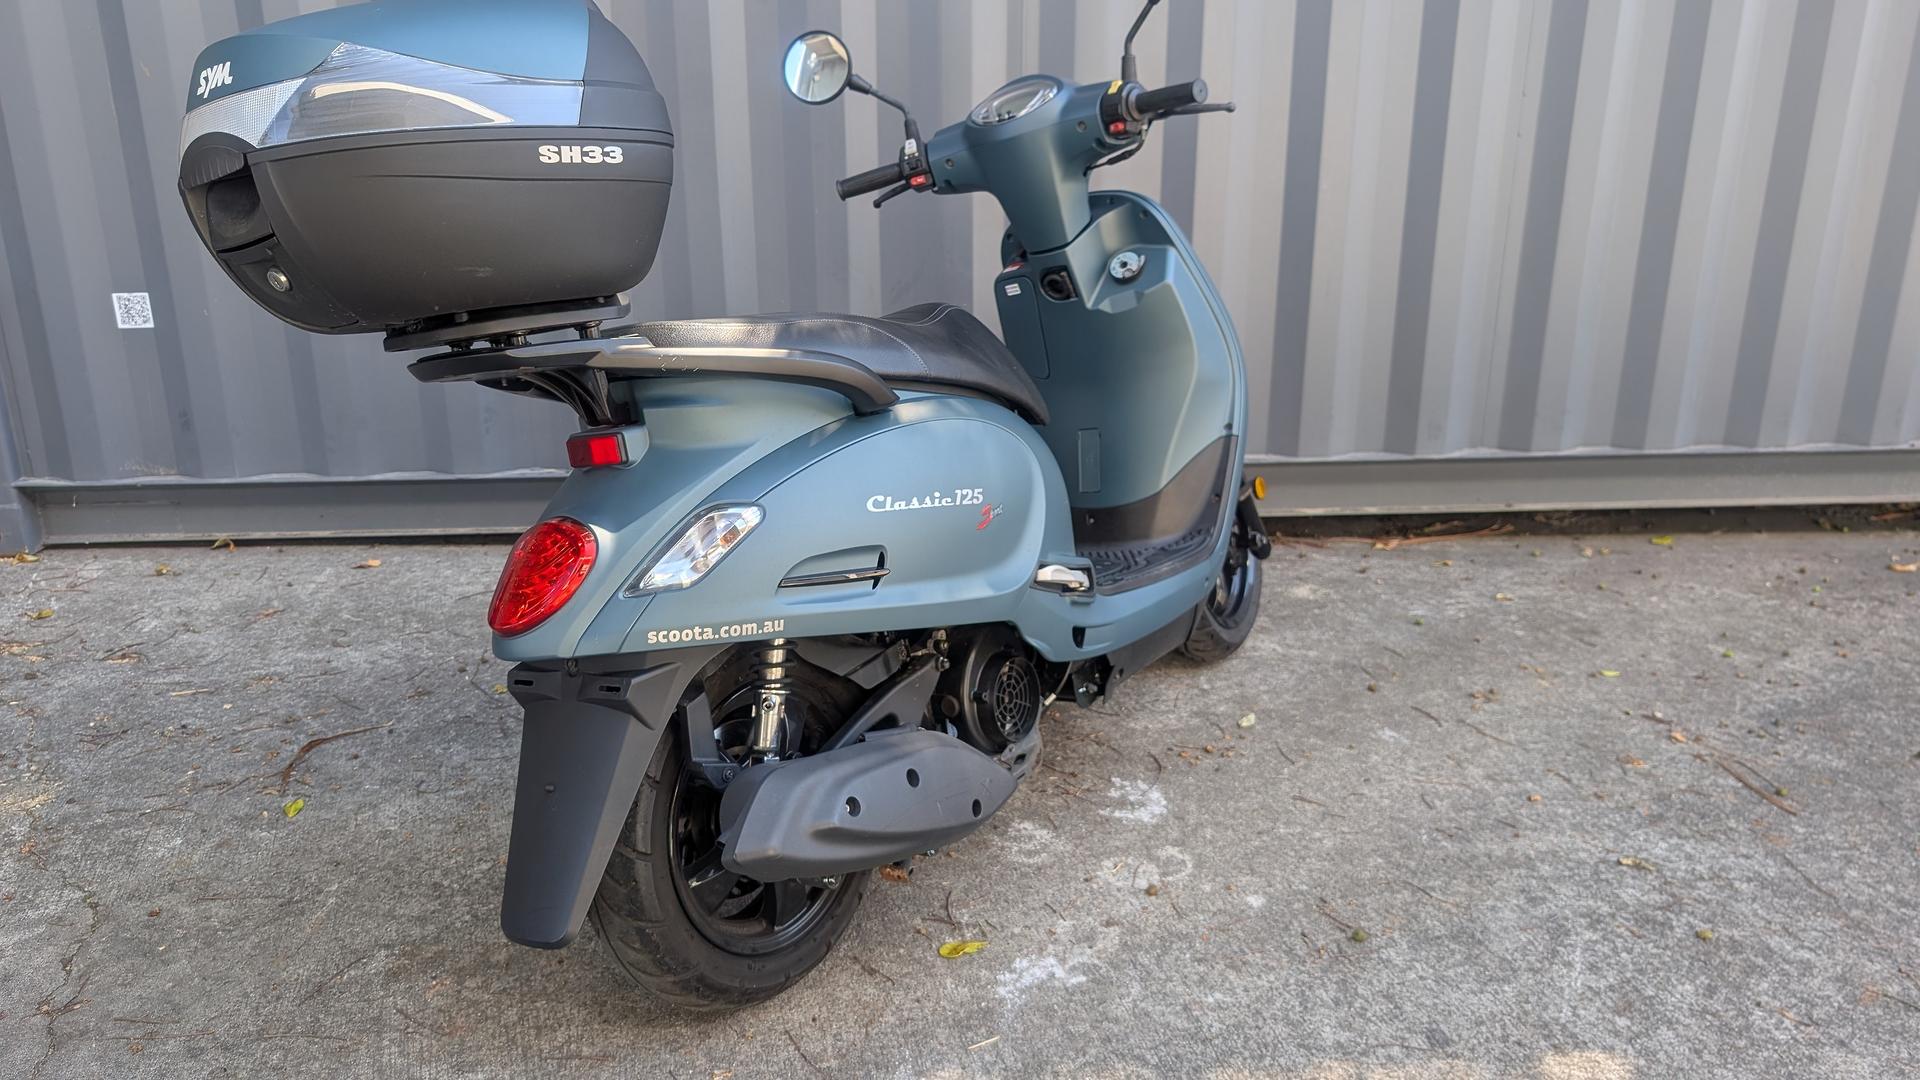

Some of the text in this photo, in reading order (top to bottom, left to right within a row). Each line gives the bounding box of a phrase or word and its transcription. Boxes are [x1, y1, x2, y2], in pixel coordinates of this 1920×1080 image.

[197, 61, 233, 98] SYM
[538, 145, 624, 164] SH33
[647, 619, 785, 644] scoota.com.au
